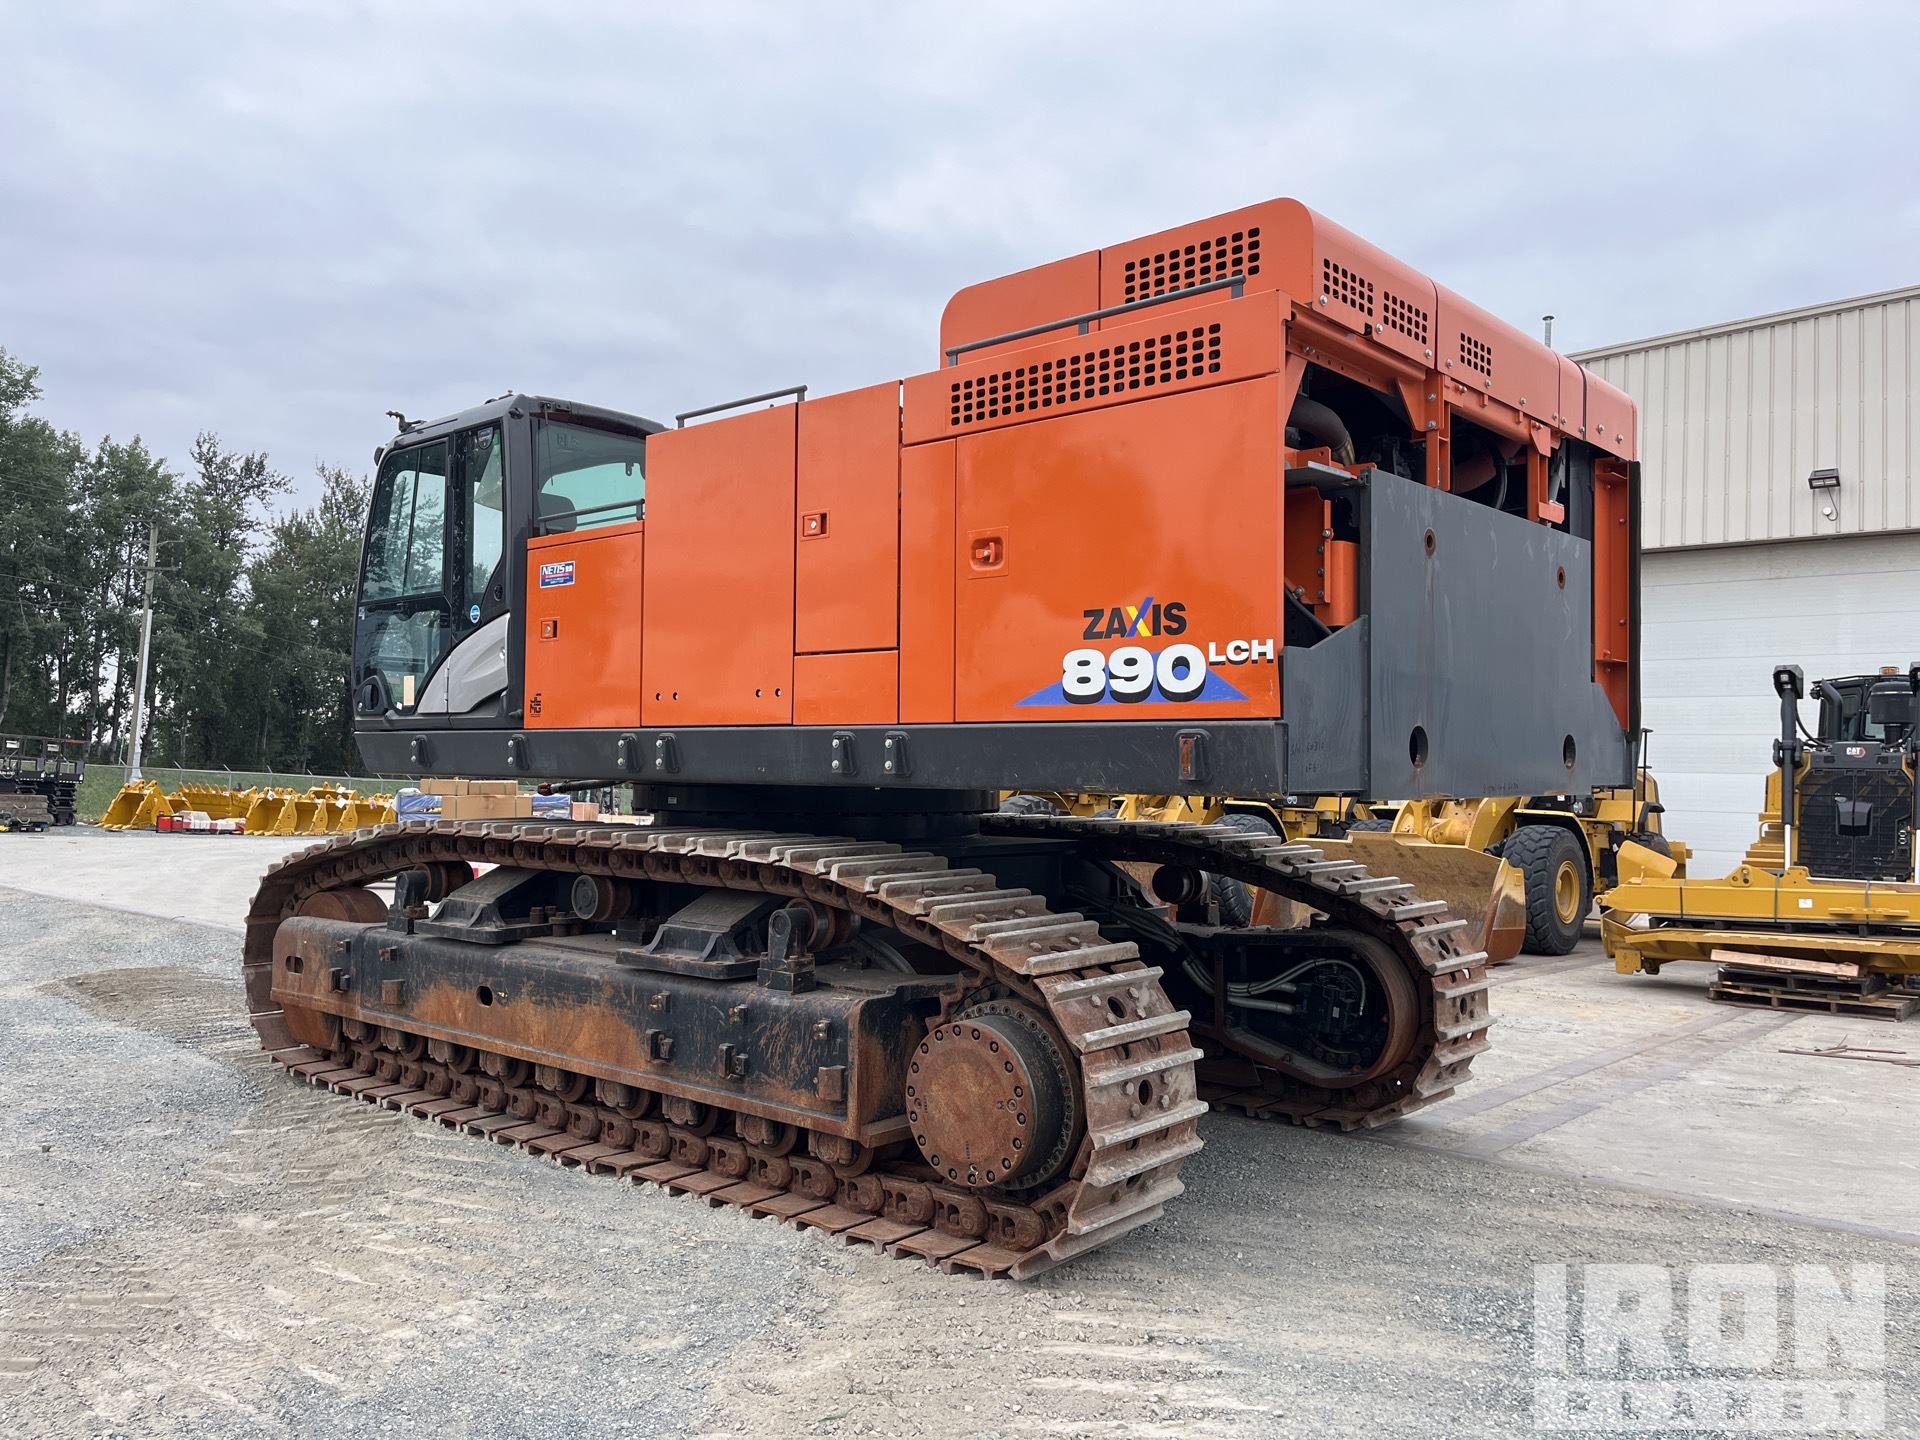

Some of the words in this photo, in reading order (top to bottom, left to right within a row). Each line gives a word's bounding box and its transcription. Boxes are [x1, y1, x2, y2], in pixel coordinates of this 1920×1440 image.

[542, 563, 566, 576] NETIS
[1082, 596, 1188, 640] ZAXIS
[1061, 643, 1207, 705] 890
[1208, 638, 1274, 666] LCH
[1846, 746, 1862, 756] CAT
